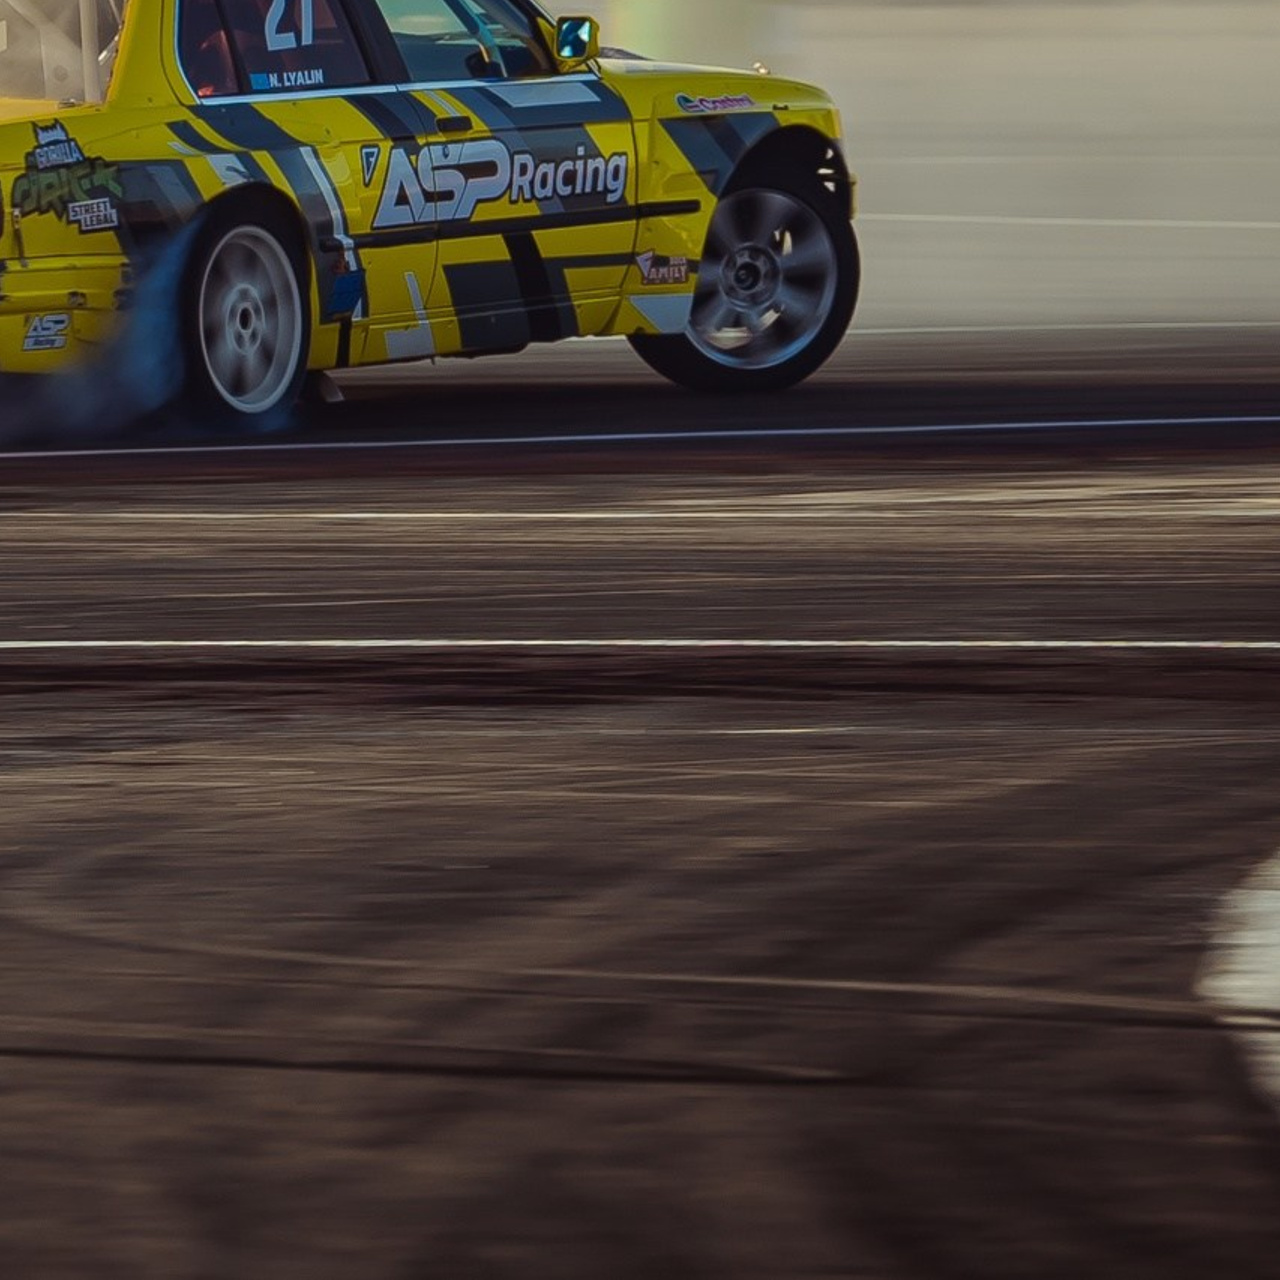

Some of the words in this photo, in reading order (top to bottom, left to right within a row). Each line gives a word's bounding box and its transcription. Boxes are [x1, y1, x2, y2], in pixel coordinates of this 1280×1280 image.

[268, 73, 282, 88] N.
[283, 68, 324, 87] LYALIN
[372, 137, 513, 229] ASP
[509, 144, 629, 204] Racing
[70, 201, 111, 219] STREET
[26, 313, 70, 337] ASP
